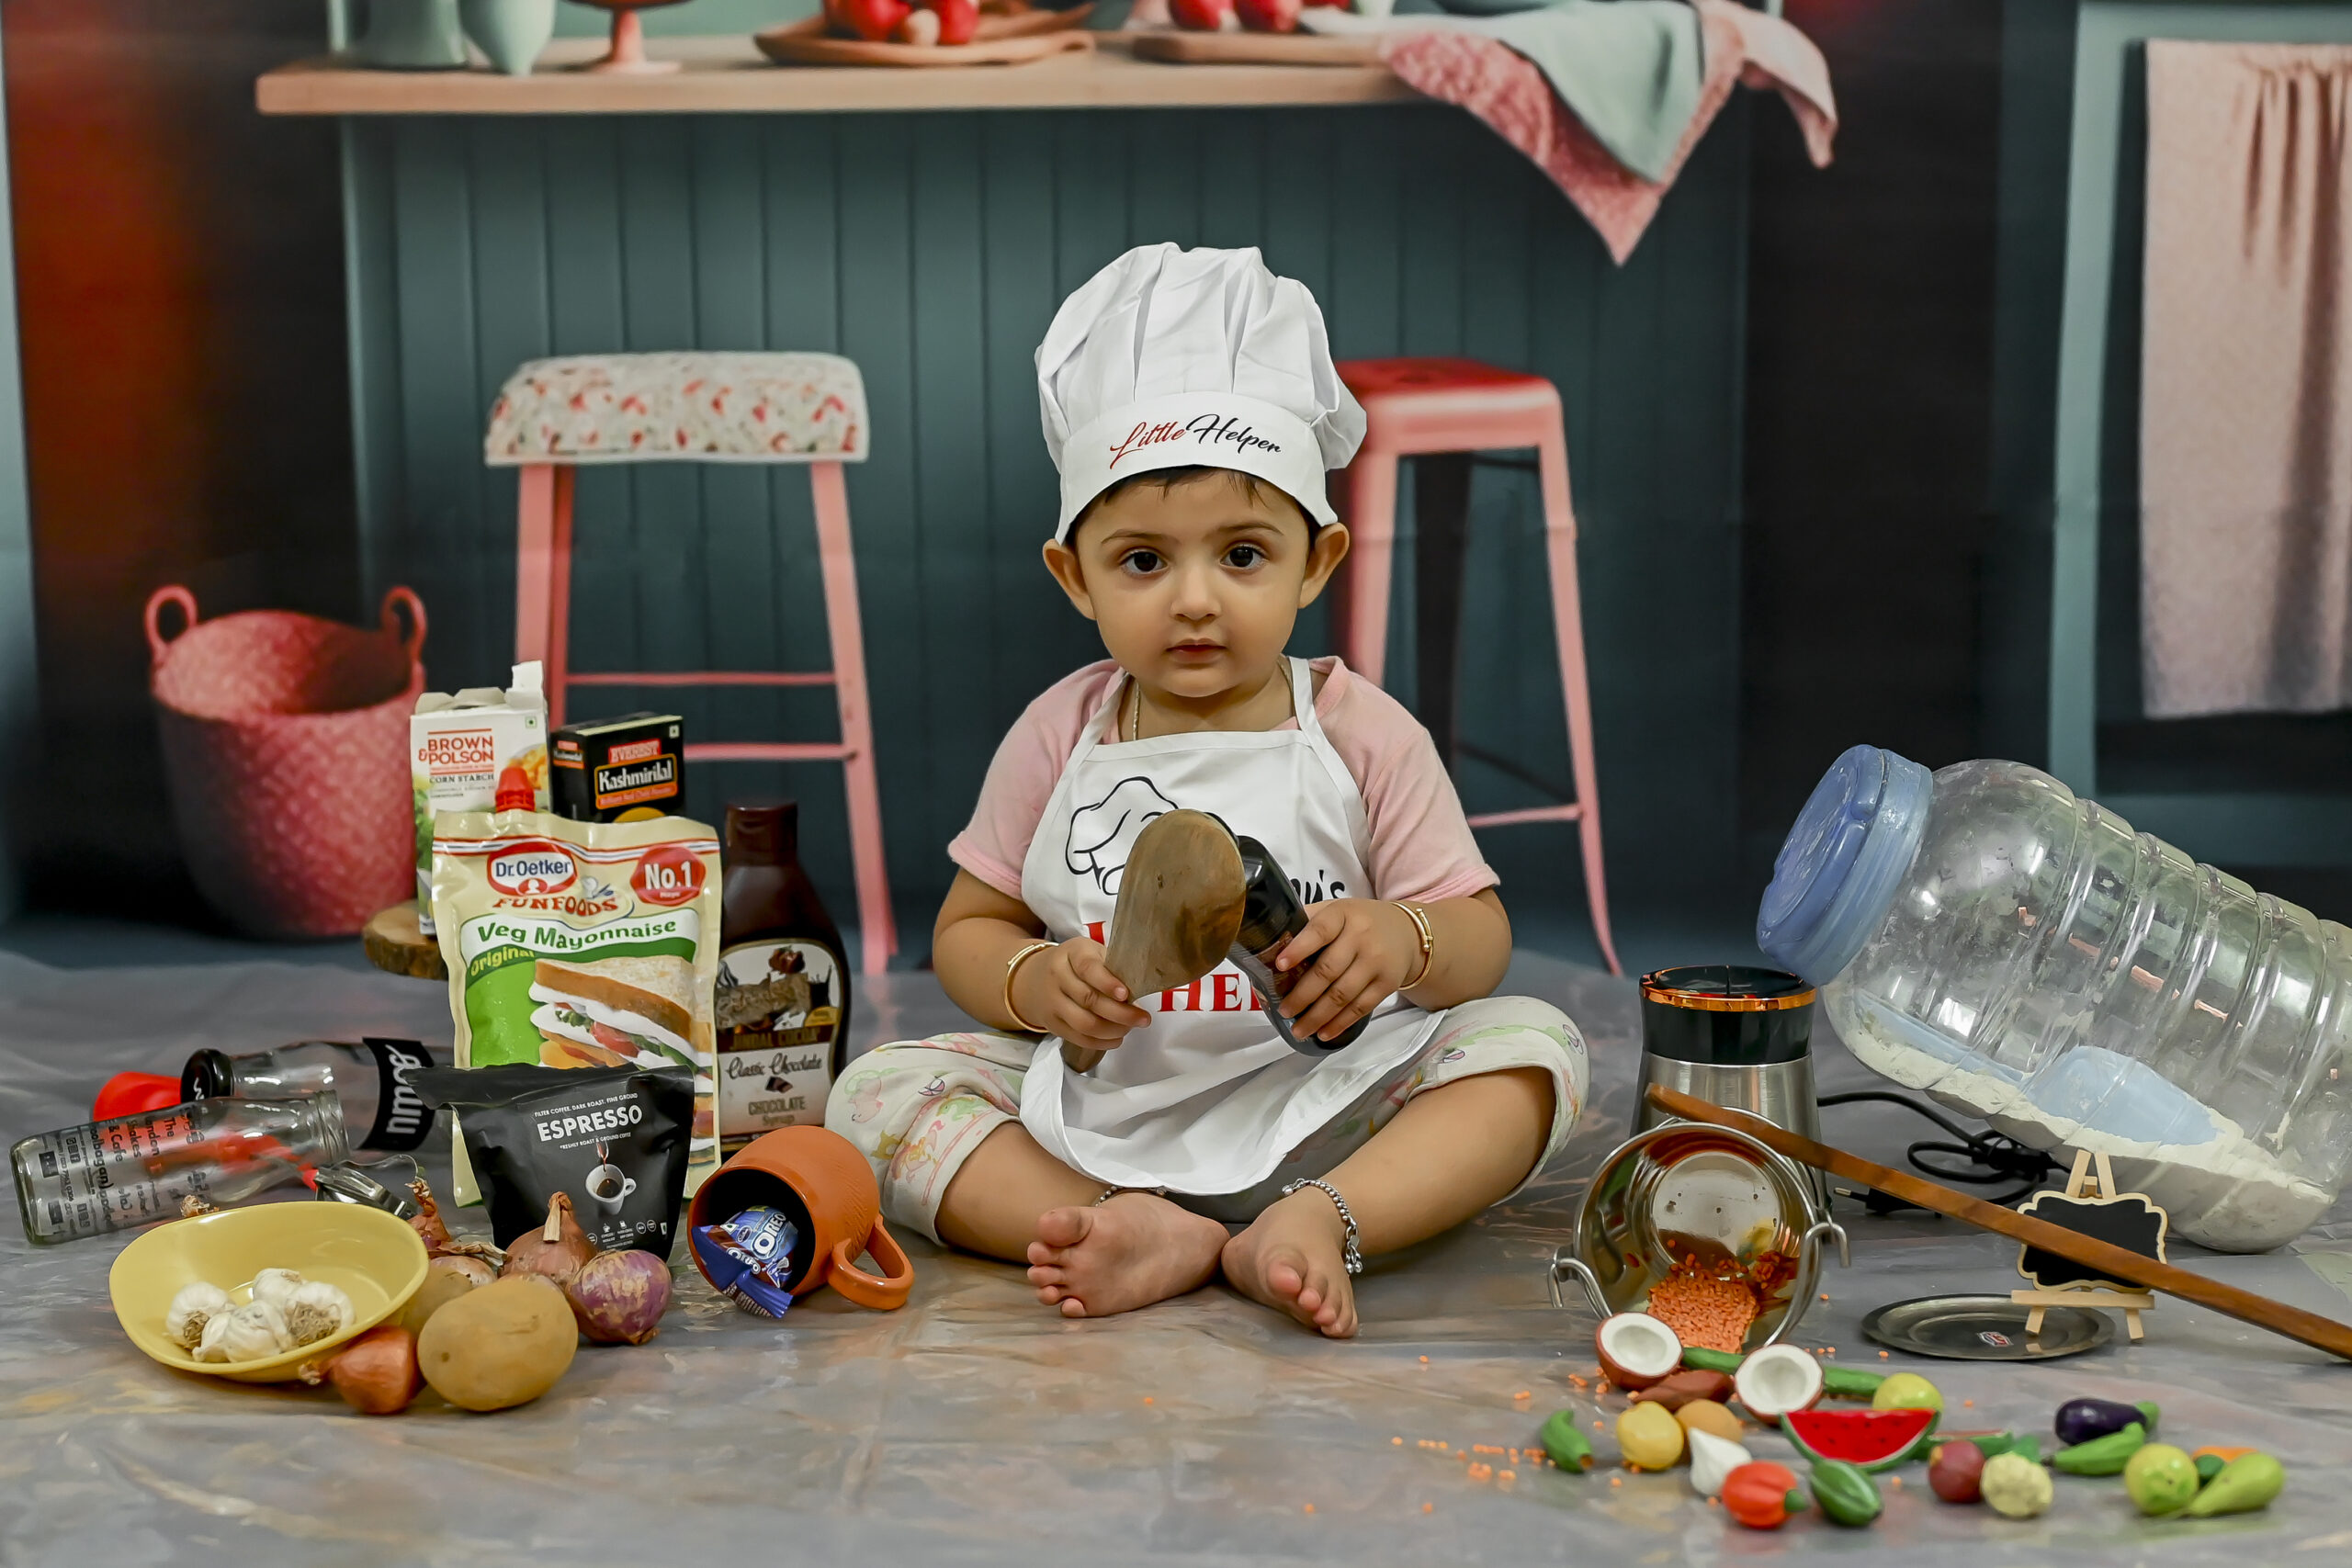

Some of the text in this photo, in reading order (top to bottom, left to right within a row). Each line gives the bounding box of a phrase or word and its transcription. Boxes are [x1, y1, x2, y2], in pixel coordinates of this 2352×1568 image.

[1109, 413, 1282, 469] Little Helper
[427, 736, 493, 751] BROWN
[428, 750, 494, 765] POLSON
[429, 775, 456, 784] CORN
[598, 759, 673, 793] Kashmirilal
[515, 860, 571, 876] Oetker
[478, 921, 676, 950] Veg Mayonnaise
[571, 1102, 587, 1111] DARK
[748, 1096, 807, 1116] CHOCOLATE
[164, 1116, 177, 1137] The
[537, 1104, 643, 1142] ESPRESSO
[752, 1213, 786, 1255] OREO
